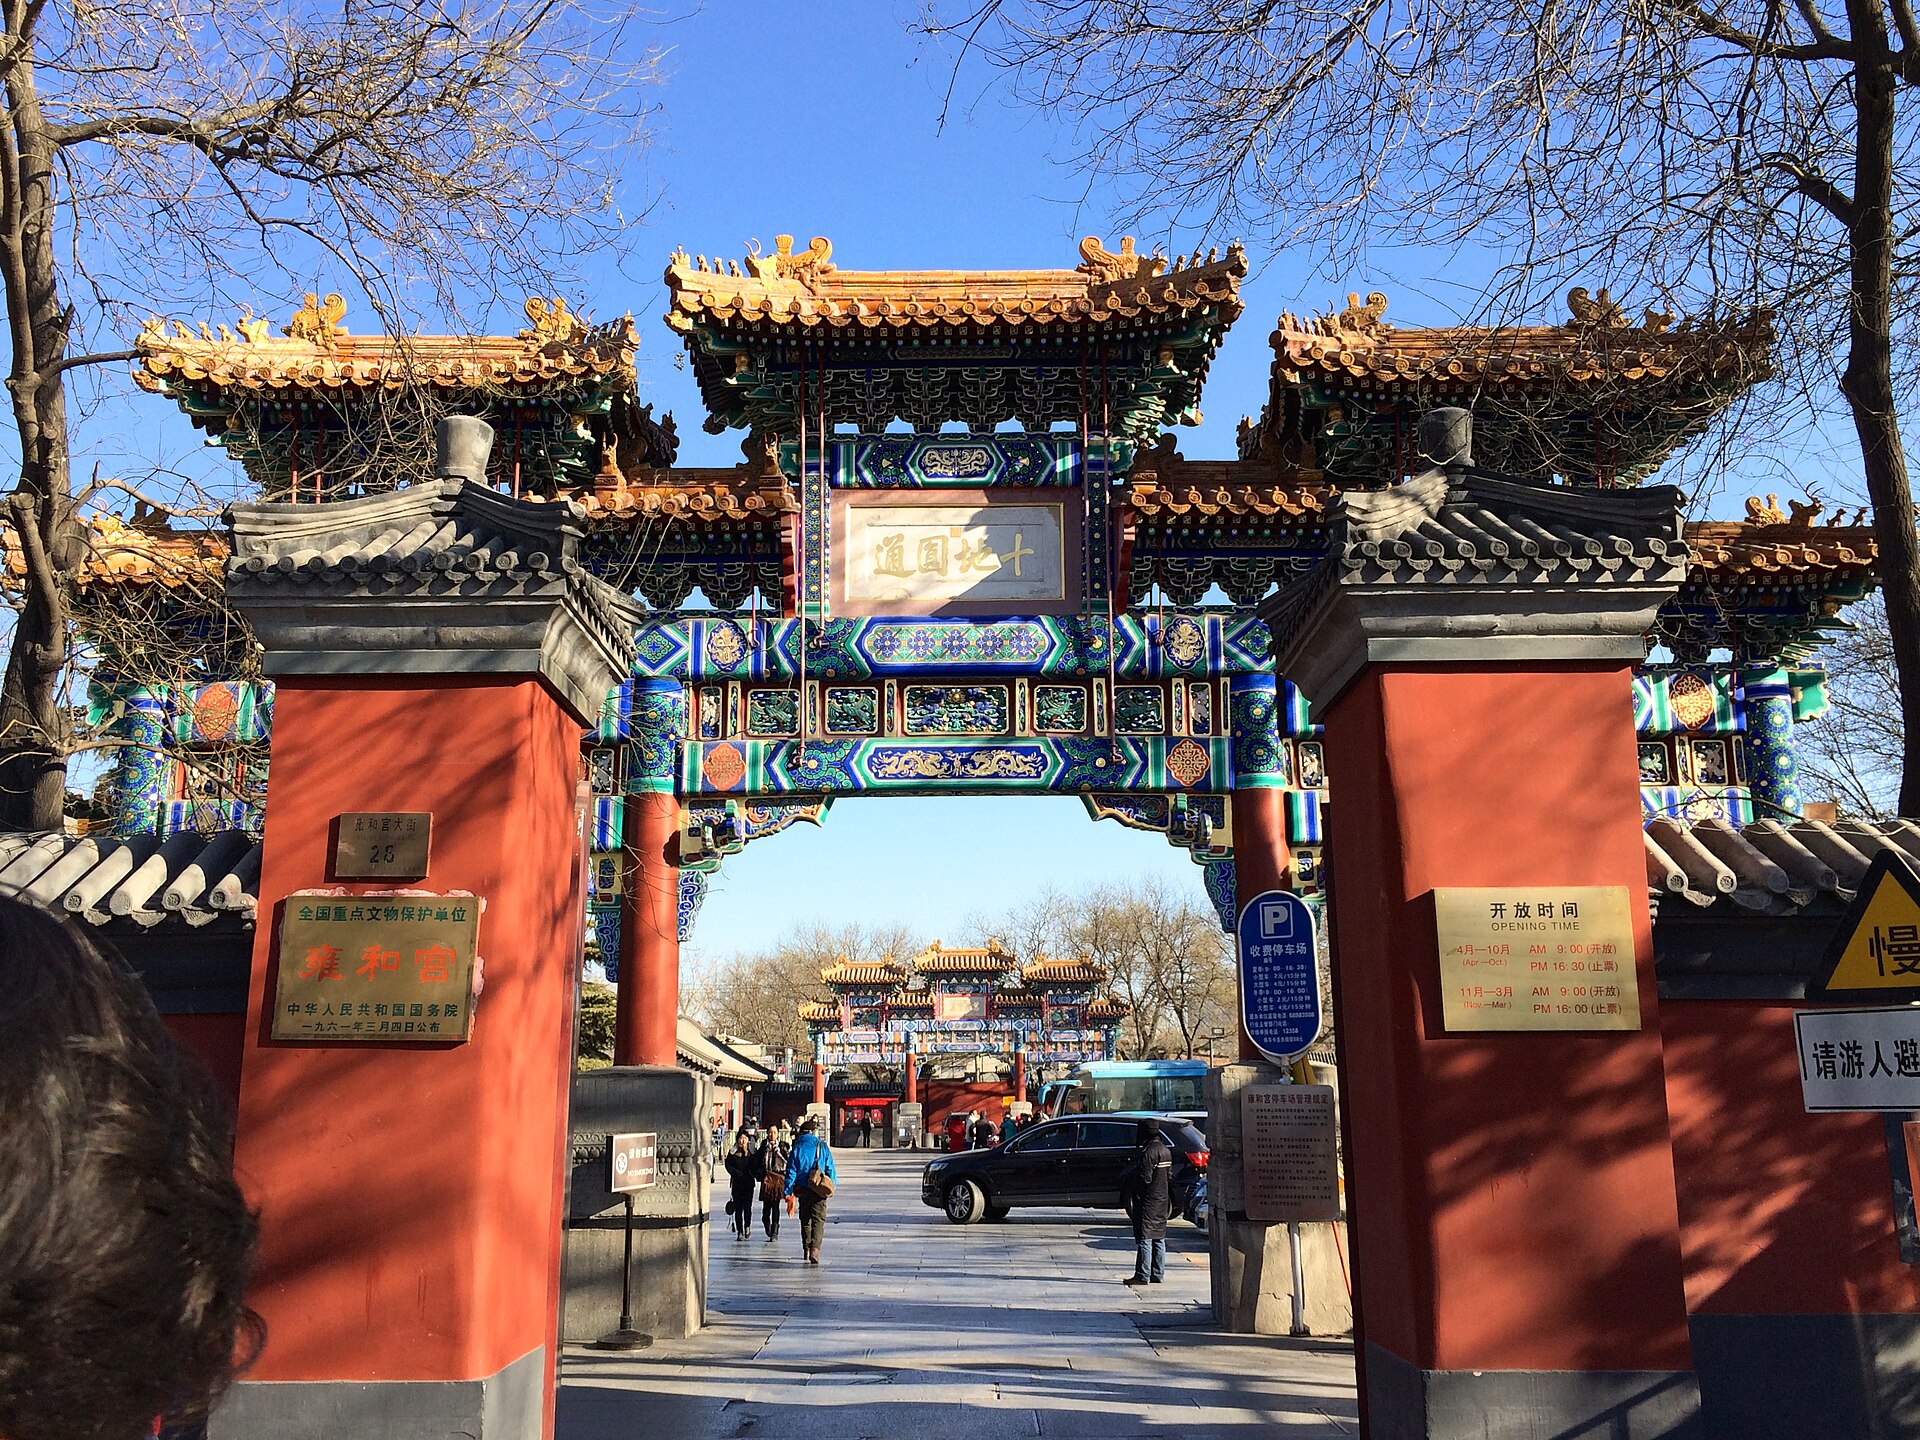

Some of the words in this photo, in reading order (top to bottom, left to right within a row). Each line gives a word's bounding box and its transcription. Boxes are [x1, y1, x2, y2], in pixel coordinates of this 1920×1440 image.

[298, 906, 466, 922] 全国重点文物保护单位
[1490, 902, 1579, 919] 开放时间
[1263, 905, 1289, 935] P
[1491, 922, 1547, 931] OPENING
[1551, 921, 1580, 931] TIME
[1250, 942, 1307, 957] 收费停车场
[1529, 945, 1547, 954] AM
[1586, 943, 1617, 955] (开放)
[1869, 924, 1920, 976] 慢
[298, 943, 456, 983] 雍和宫
[1530, 962, 1548, 971] PM
[1587, 961, 1619, 972] (止票)
[1532, 987, 1550, 996] AM
[1589, 986, 1620, 997] (开放)
[287, 1003, 458, 1018] 中华人民共和国国务院
[1533, 1004, 1551, 1013] PM
[1590, 1003, 1622, 1015] (止票)
[302, 1021, 441, 1033] 一九六一年三月四日公布
[1812, 1038, 1920, 1080] 请游人避
